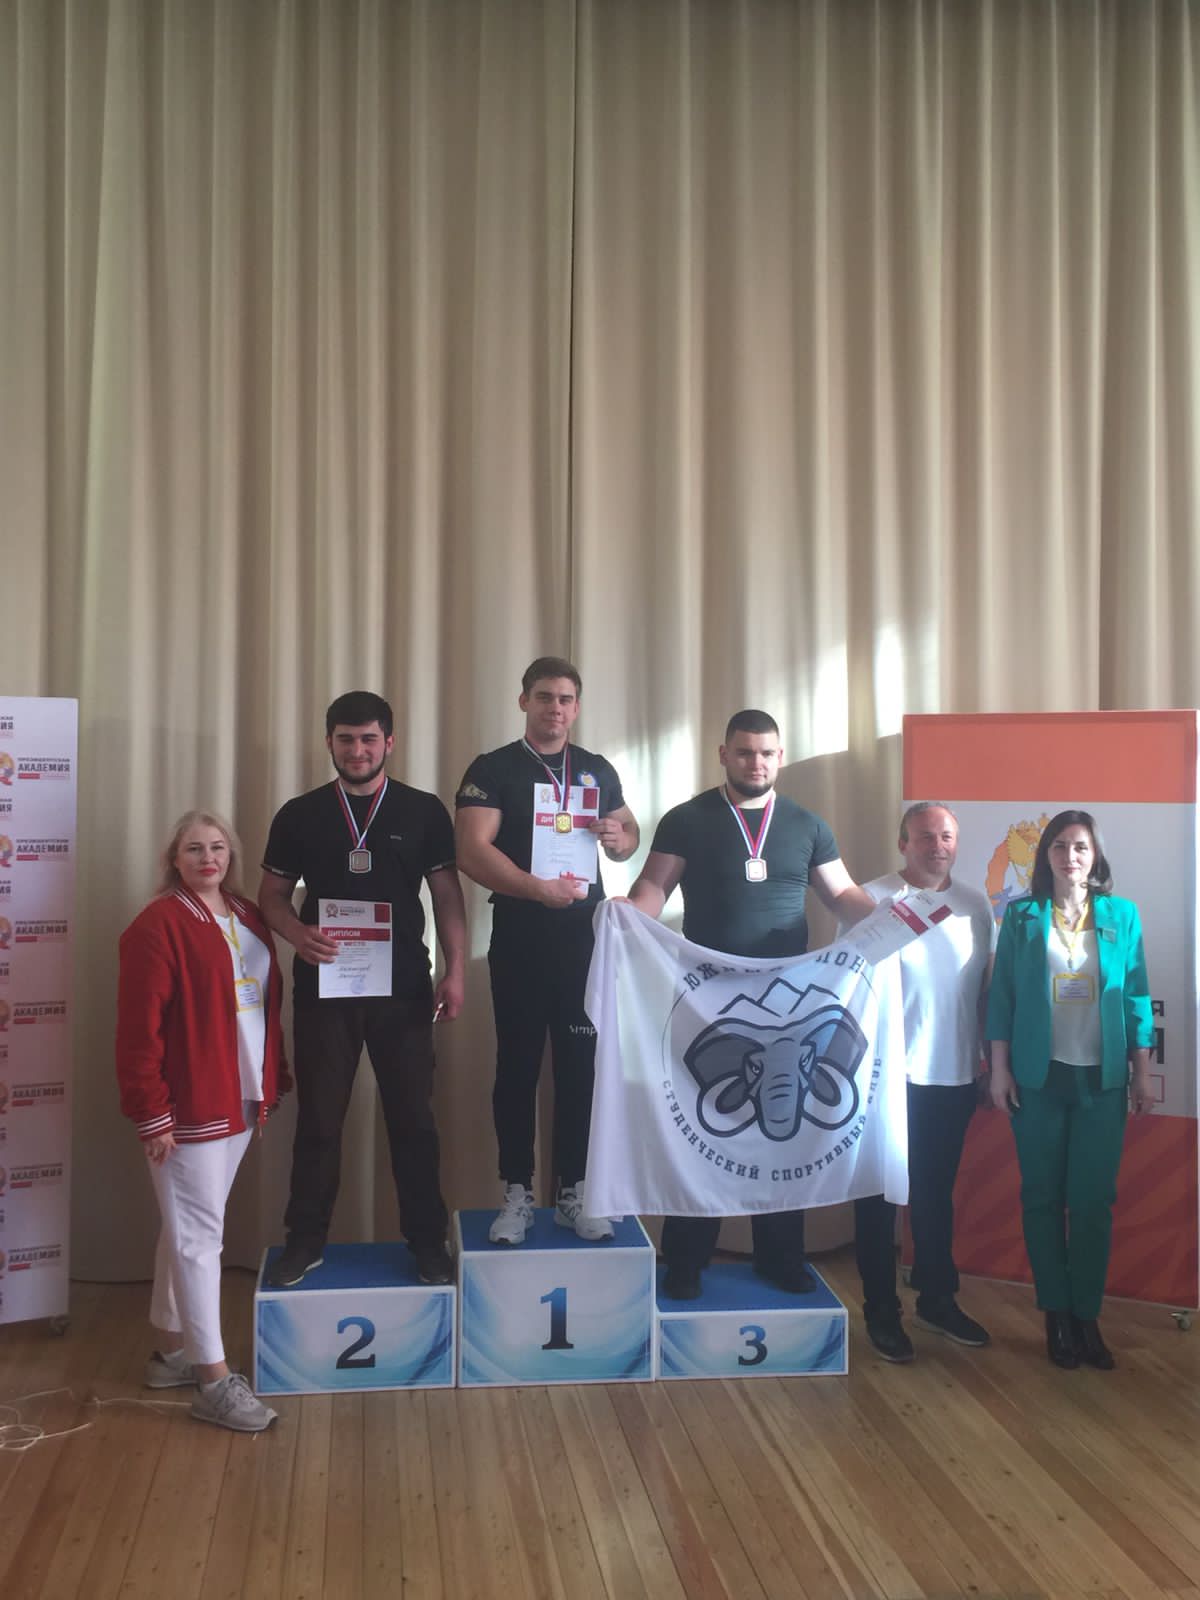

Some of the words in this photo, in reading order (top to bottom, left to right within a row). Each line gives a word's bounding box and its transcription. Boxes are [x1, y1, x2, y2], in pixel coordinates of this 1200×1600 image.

[18, 763, 70, 772] АКАДЕМИЯ
[16, 844, 69, 853] АКАДЕМИЯ
[16, 925, 68, 935] АКАДЕМИЯ
[663, 1080, 760, 1180] СТУДЕНЧЕСКИЙ
[771, 1115, 866, 1182] СПОРТИВНЫЙ
[540, 1287, 574, 1350] 1
[336, 1316, 376, 1369] 2
[738, 1325, 767, 1365] 3
